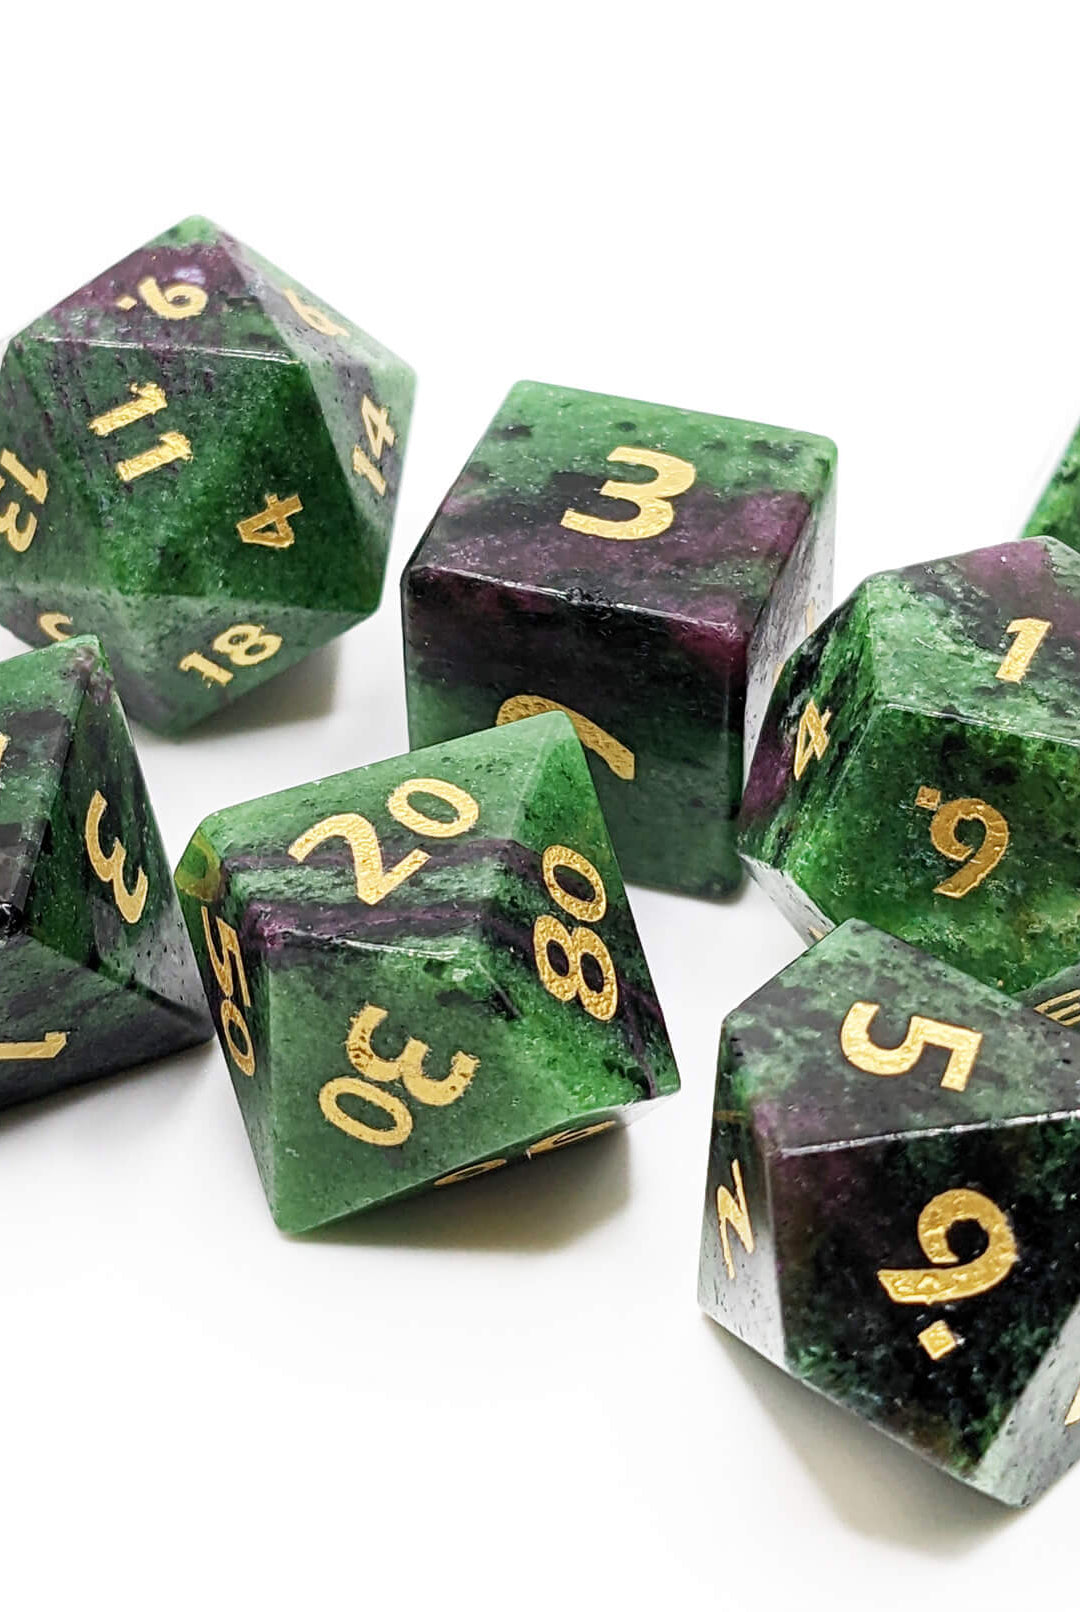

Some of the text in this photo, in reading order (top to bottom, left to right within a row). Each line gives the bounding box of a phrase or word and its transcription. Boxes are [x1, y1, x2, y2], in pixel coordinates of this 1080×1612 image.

[88, 380, 193, 481] 11
[352, 394, 396, 497] 14
[236, 494, 304, 550] 4
[560, 445, 696, 541] 3
[178, 623, 282, 688] 18
[996, 616, 1054, 684] 1
[794, 699, 832, 781] 4
[84, 791, 148, 924] 3
[288, 777, 480, 906] 20
[532, 844, 619, 1022] 80
[201, 906, 256, 1077] 50
[318, 1002, 481, 1147] 30
[838, 999, 984, 1093] 5
